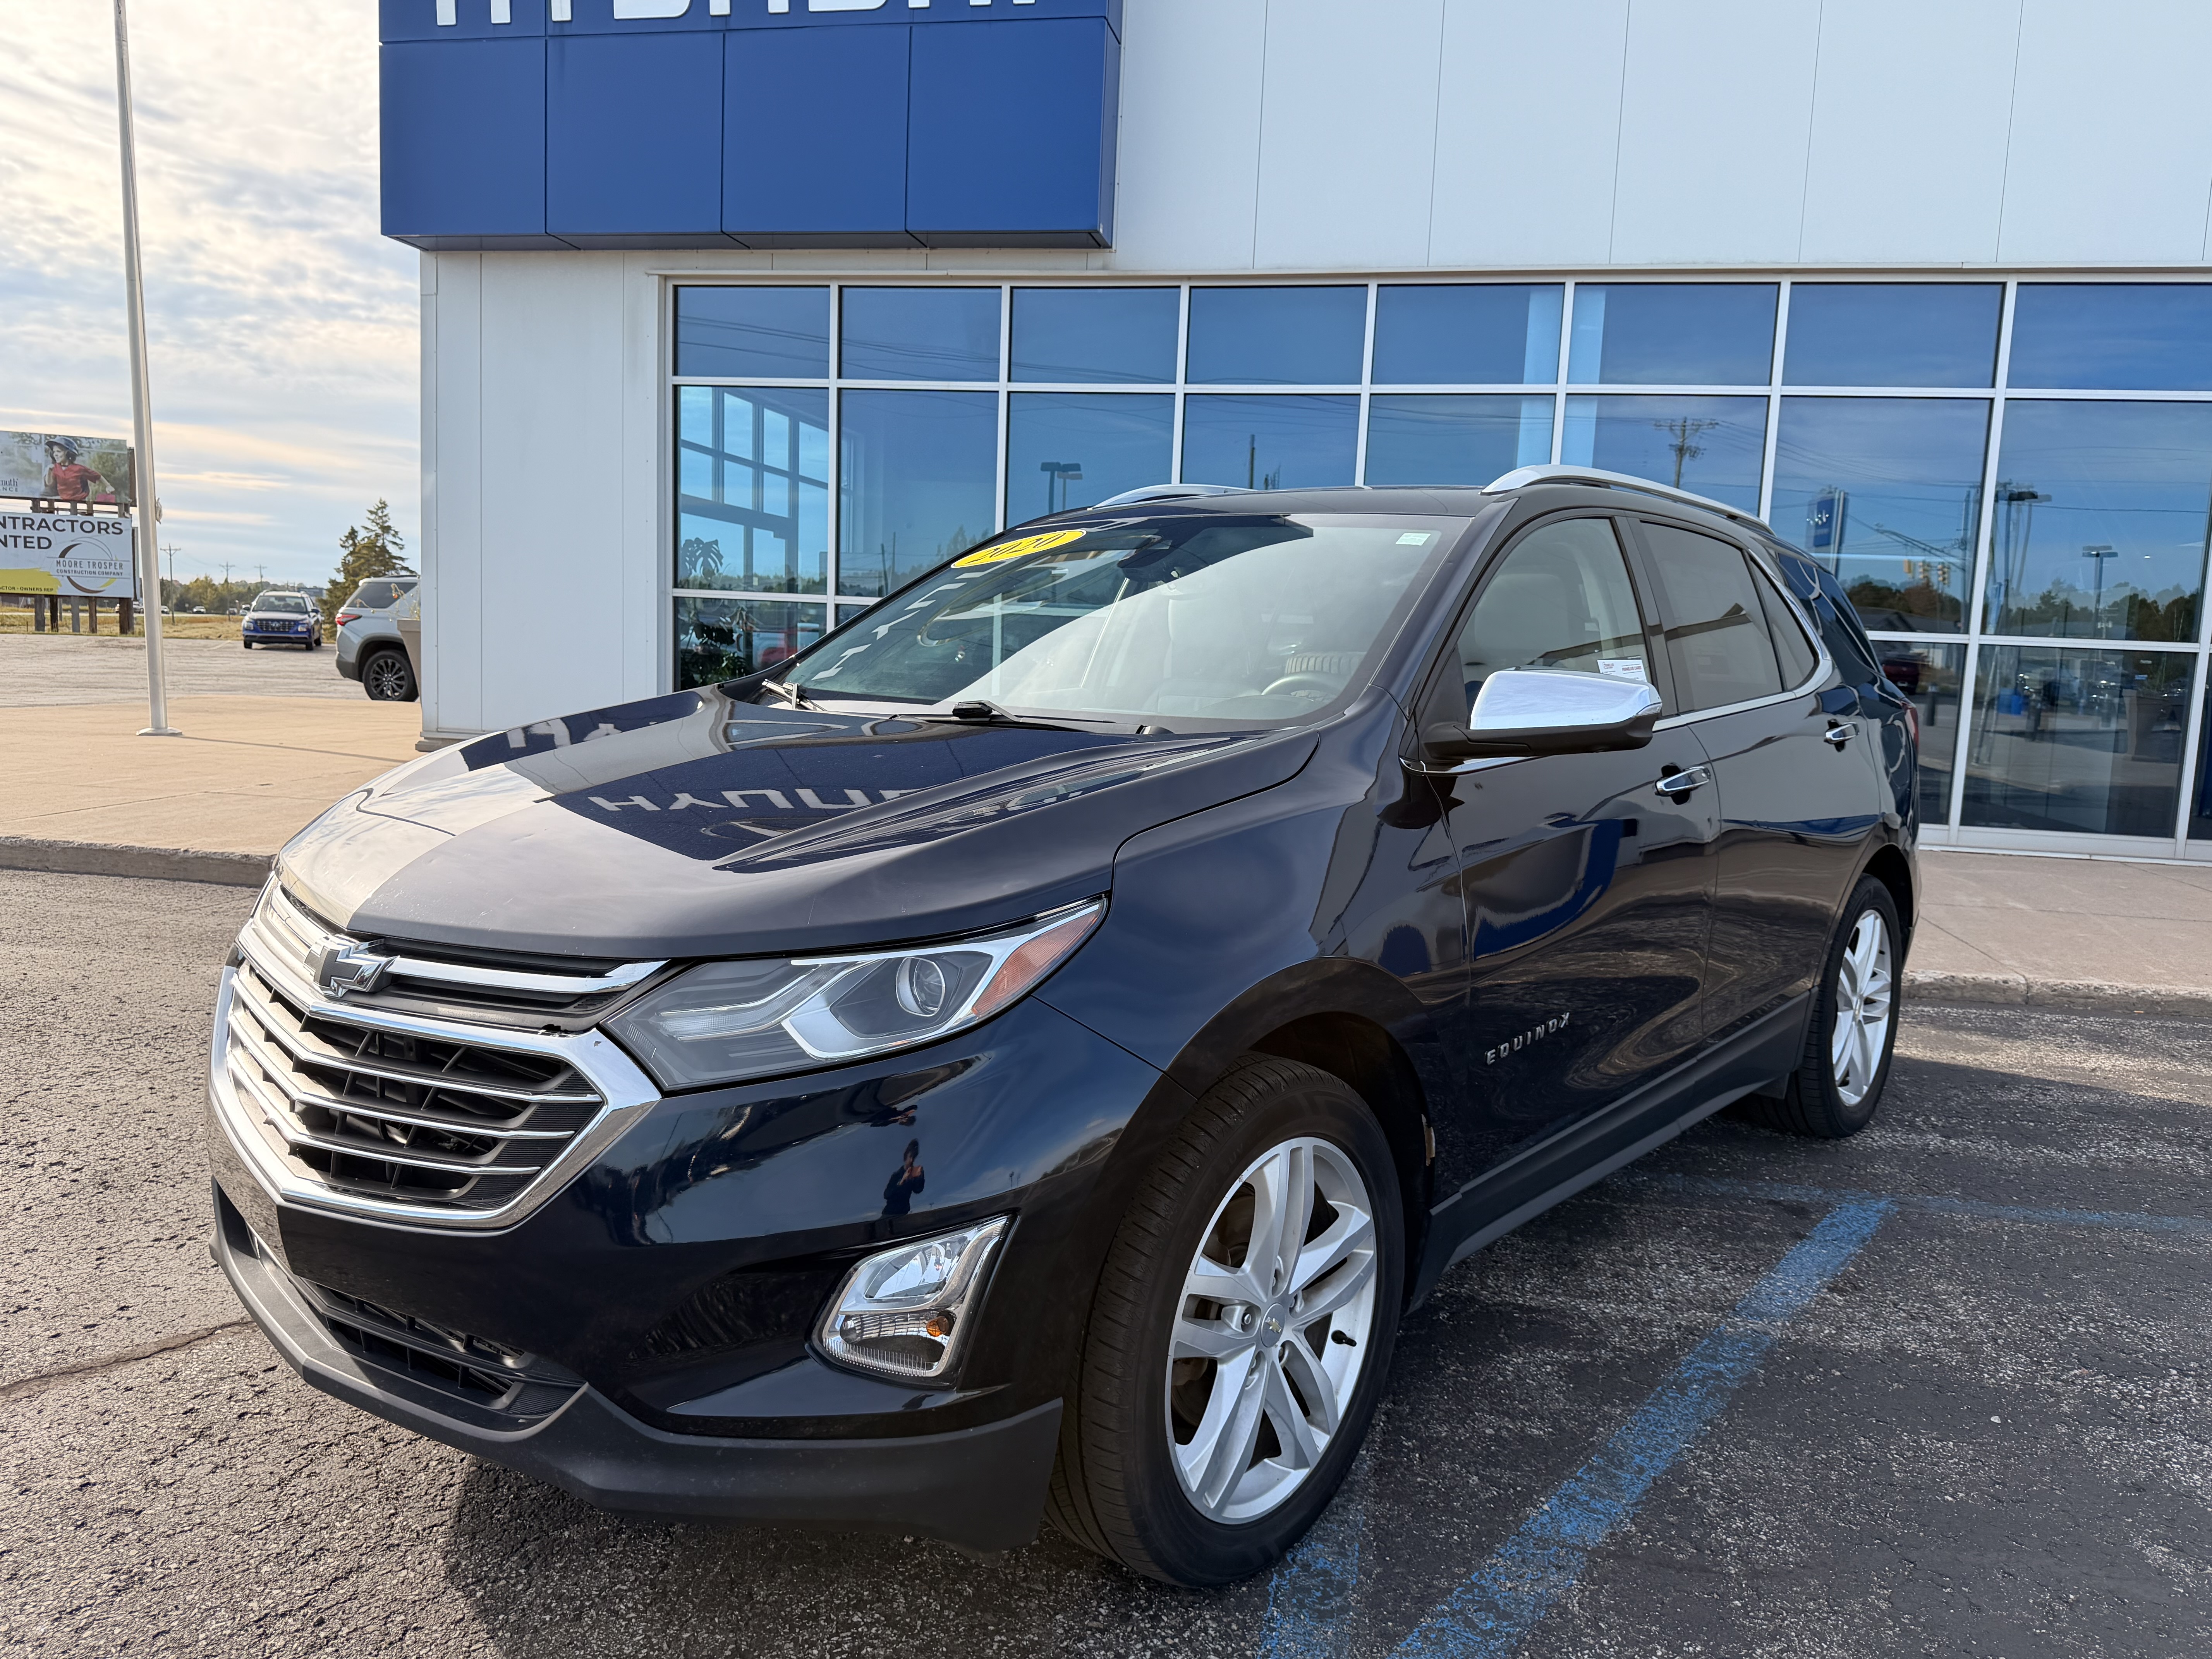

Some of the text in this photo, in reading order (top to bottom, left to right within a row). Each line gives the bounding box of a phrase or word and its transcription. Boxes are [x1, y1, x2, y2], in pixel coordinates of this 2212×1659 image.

[964, 532, 1066, 564] 2020
[56, 560, 123, 570] MOORE TROSPER
[1485, 1012, 1570, 1065] EQUINOX
